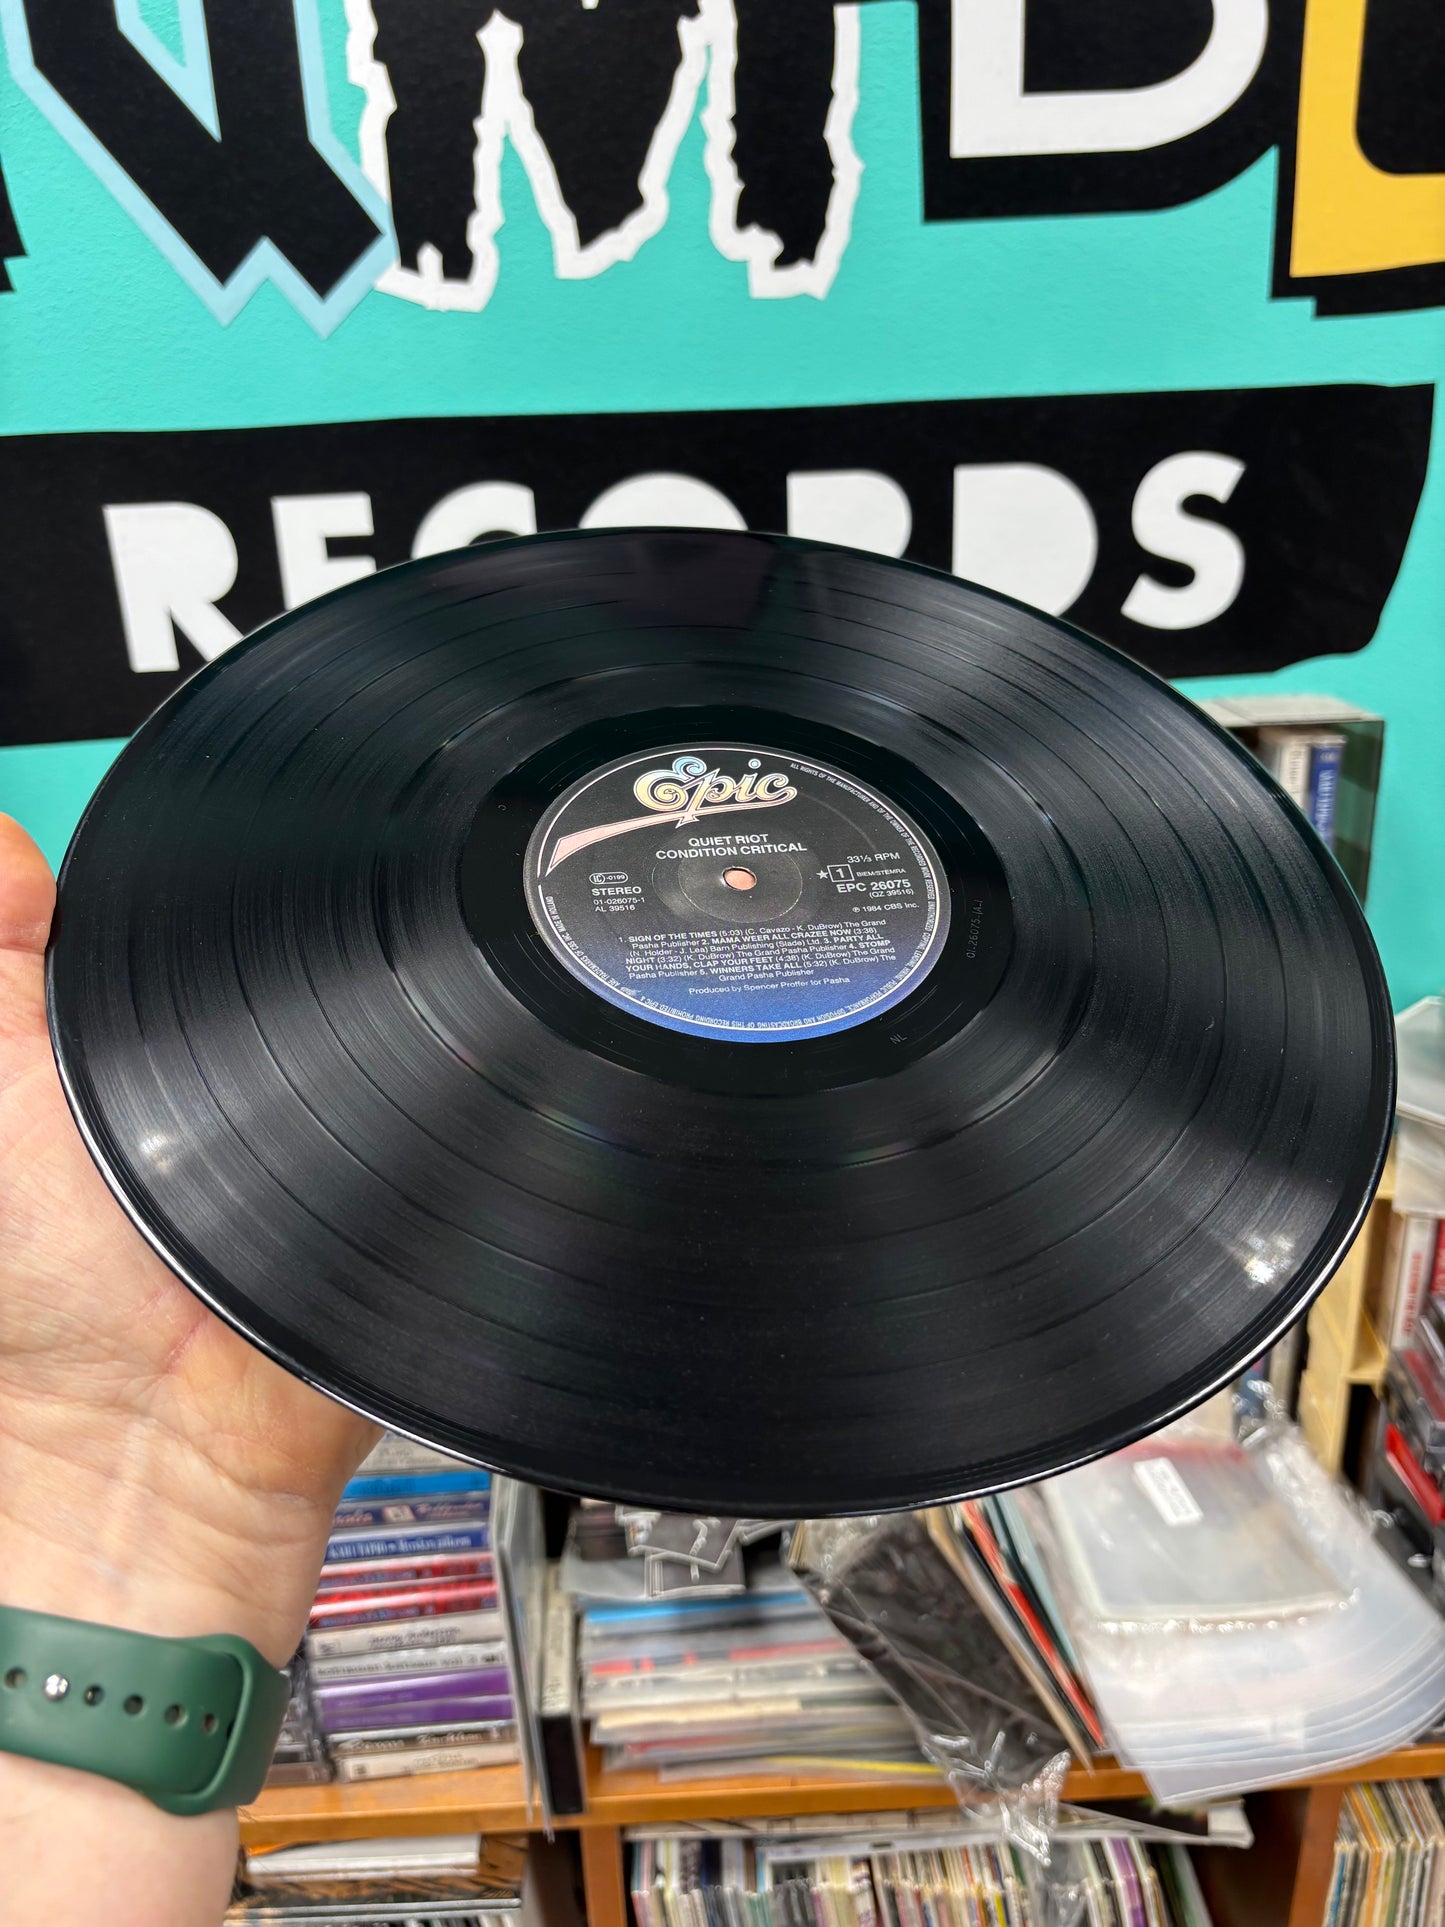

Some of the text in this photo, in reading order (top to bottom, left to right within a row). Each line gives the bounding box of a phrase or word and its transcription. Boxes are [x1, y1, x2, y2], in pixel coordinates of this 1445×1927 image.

[633, 756, 797, 828] Epic
[689, 834, 768, 846] QUIET RIOT
[656, 843, 807, 859] CONDITION CRITICAL
[875, 852, 900, 861] RPM
[836, 868, 844, 878] 1
[592, 886, 641, 896] STEREO
[837, 879, 911, 893] EPC 26075
[808, 922, 842, 930] DuBrow)
[661, 940, 700, 948] Publisher
[791, 931, 828, 939] CRAZEE
[690, 946, 708, 954] Lea)
[732, 942, 774, 950] Publishing
[810, 944, 847, 952] Publisher
[859, 940, 890, 948] STOMP
[693, 960, 719, 968] CLAP
[750, 956, 774, 964] FEET
[710, 966, 754, 974] WINNERS
[843, 957, 879, 965] DuBrow)
[689, 987, 729, 995] Produced
[744, 983, 778, 991] Spencer
